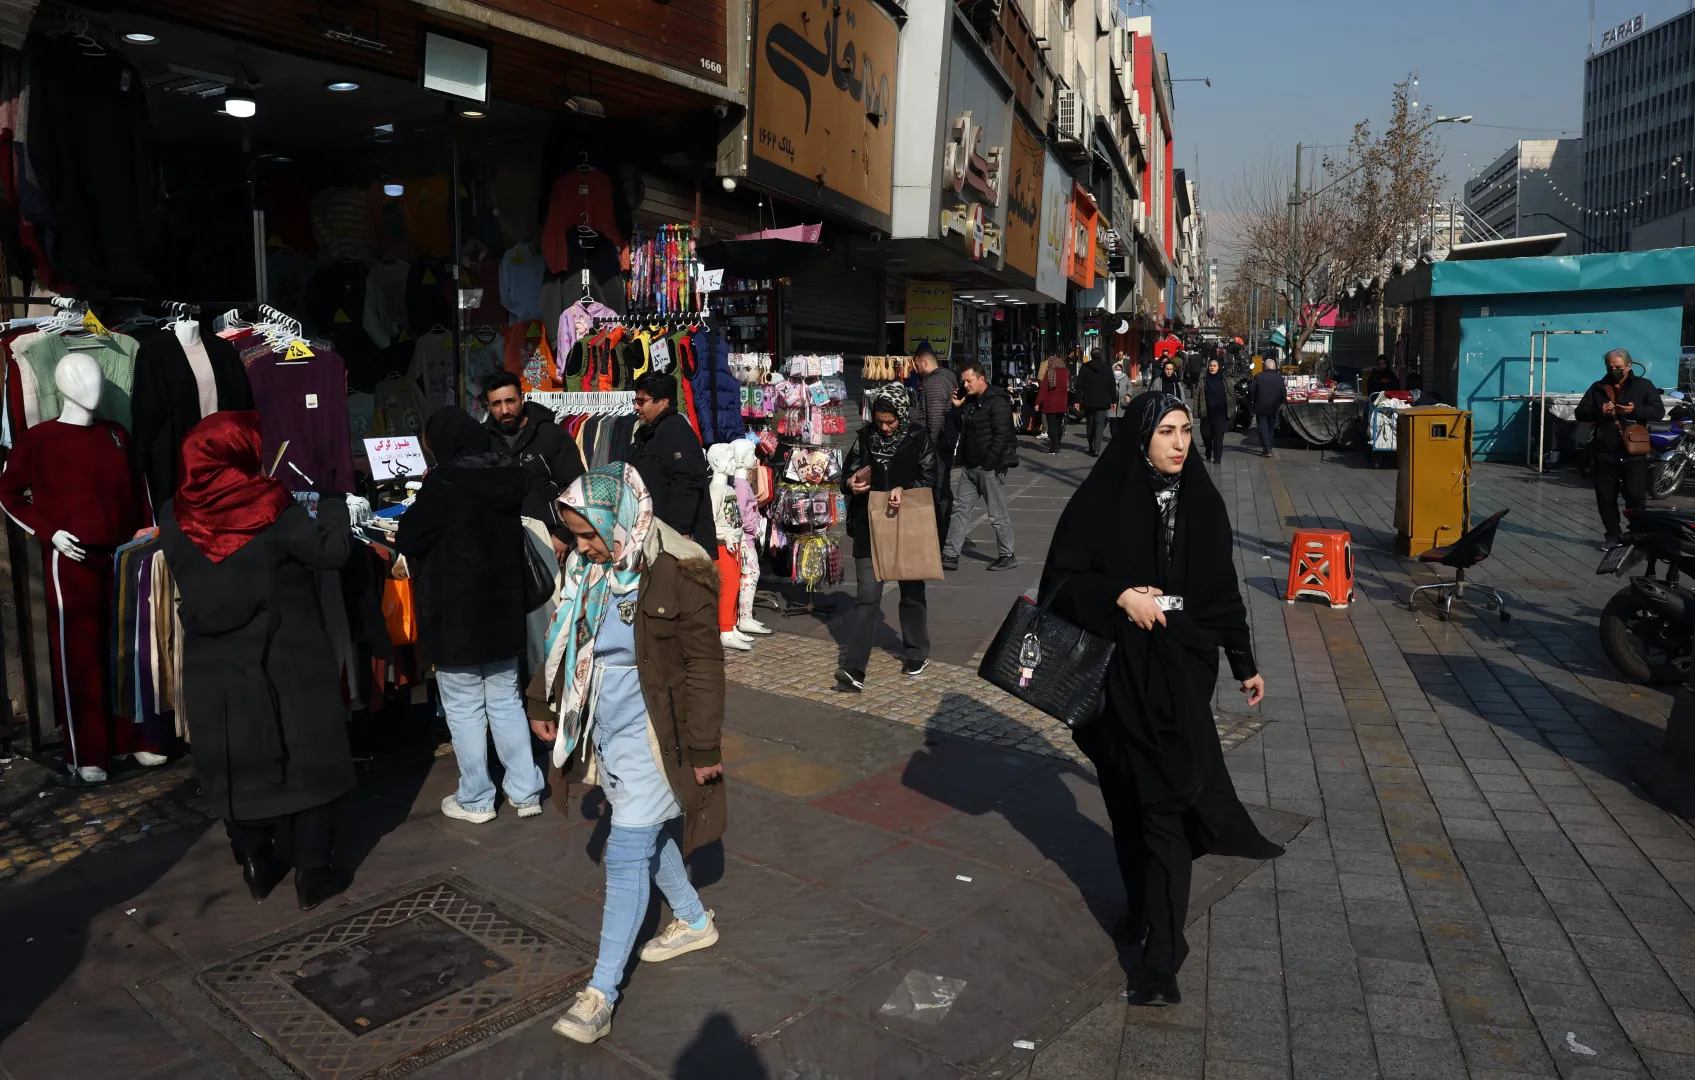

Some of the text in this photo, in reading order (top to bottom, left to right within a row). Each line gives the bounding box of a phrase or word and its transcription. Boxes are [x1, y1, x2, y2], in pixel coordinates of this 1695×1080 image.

[1601, 15, 1643, 48] FARAB
[699, 57, 722, 75] 1660
[778, 137, 795, 164] پلاک
[374, 438, 411, 451] بلوز گرکی
